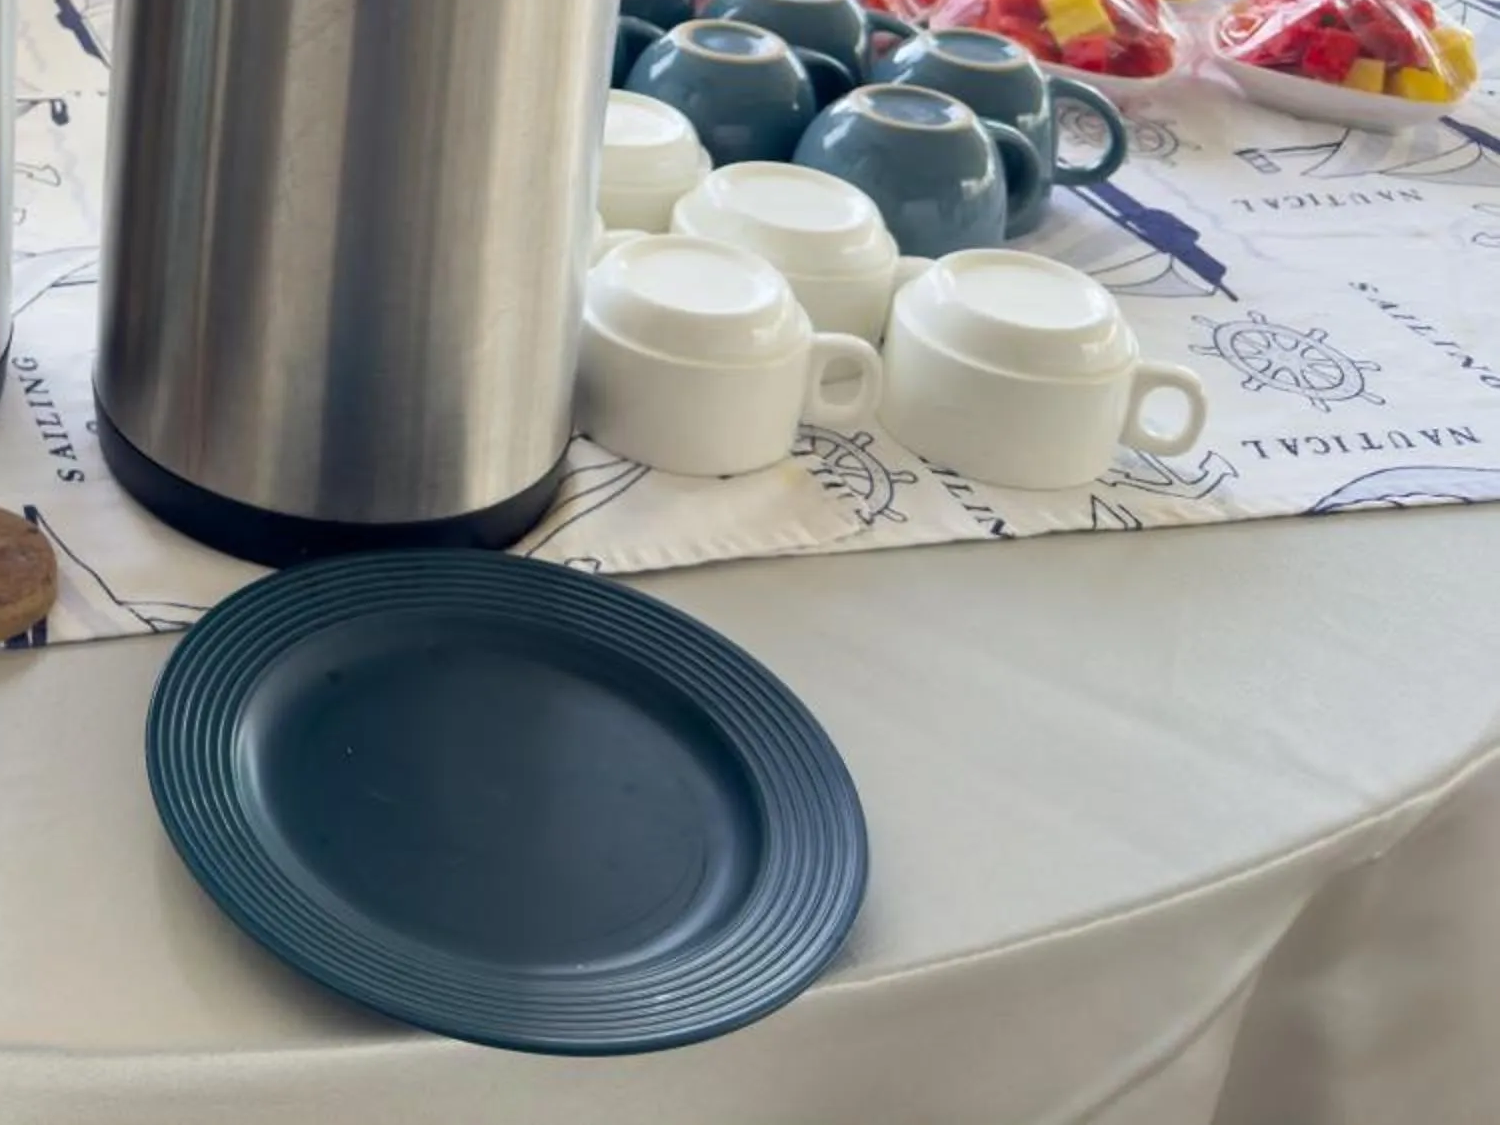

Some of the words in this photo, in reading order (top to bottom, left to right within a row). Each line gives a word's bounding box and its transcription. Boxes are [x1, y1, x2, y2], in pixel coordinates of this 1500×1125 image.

[1230, 188, 1425, 213] NAUTICAL
[11, 356, 85, 483] SAILING
[1240, 425, 1482, 460] NAUTICAL
